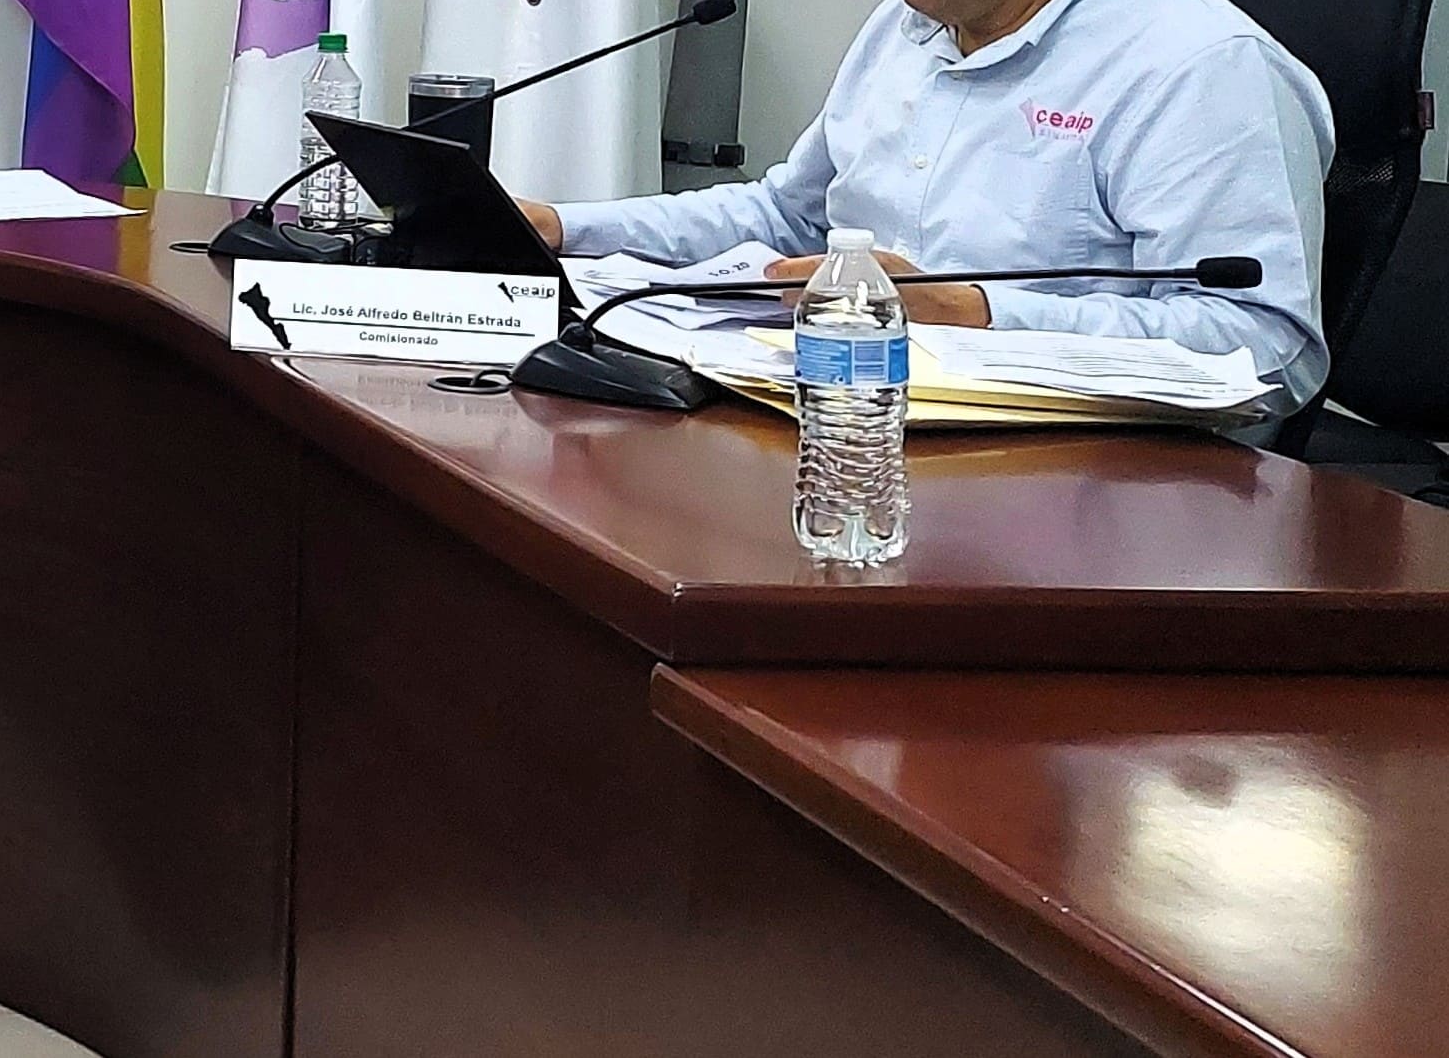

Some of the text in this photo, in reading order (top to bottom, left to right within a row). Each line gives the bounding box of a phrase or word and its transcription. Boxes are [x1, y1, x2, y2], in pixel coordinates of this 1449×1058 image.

[1036, 109, 1094, 133] ceaip
[510, 285, 557, 299] ceaip
[292, 302, 522, 328] Lic. José Alfredo Beltrán Estrada
[359, 331, 439, 346] Comisionado
